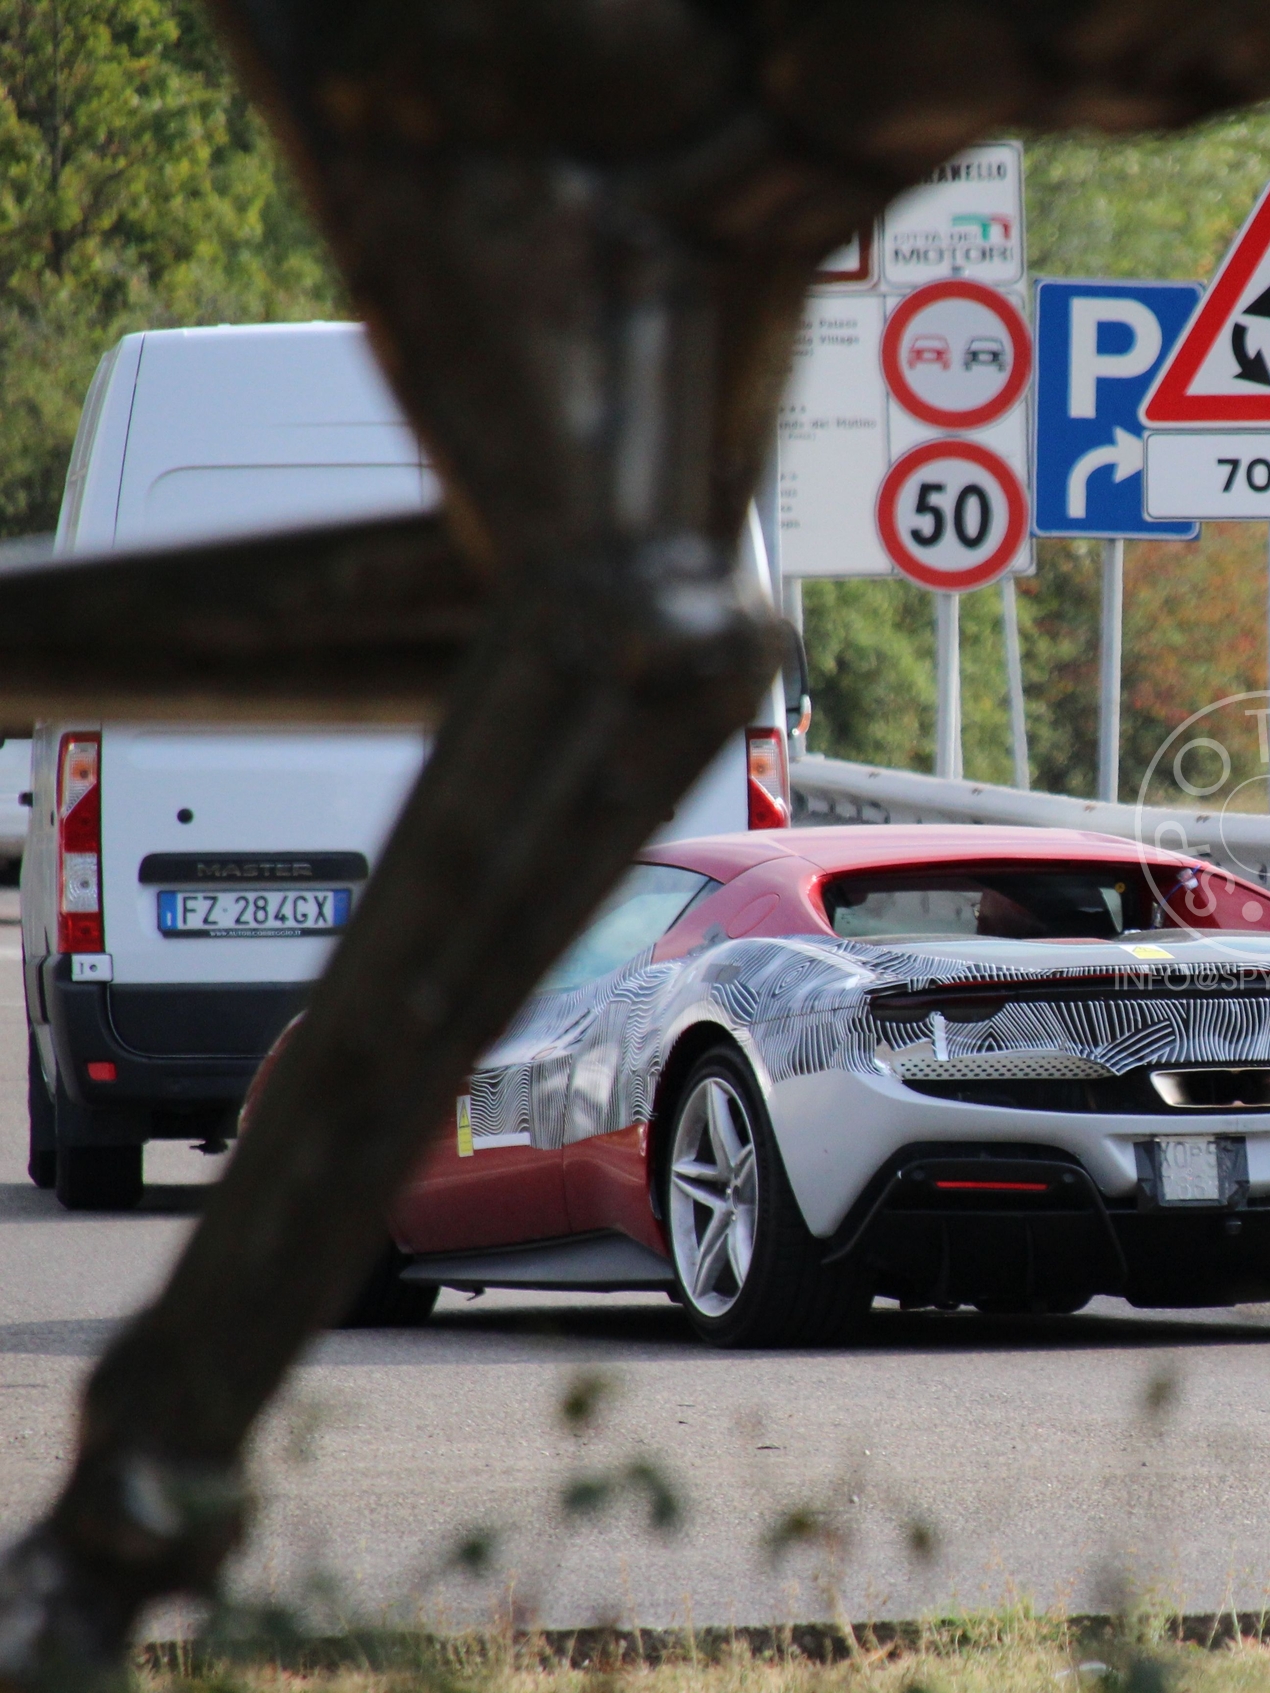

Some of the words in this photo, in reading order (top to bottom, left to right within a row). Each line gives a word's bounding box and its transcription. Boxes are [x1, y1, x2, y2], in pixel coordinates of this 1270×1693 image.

[1069, 297, 1163, 419] P
[910, 482, 994, 551] 50
[197, 863, 313, 878] MASTER
[182, 895, 219, 926] FZ
[234, 894, 329, 926] 284GX
